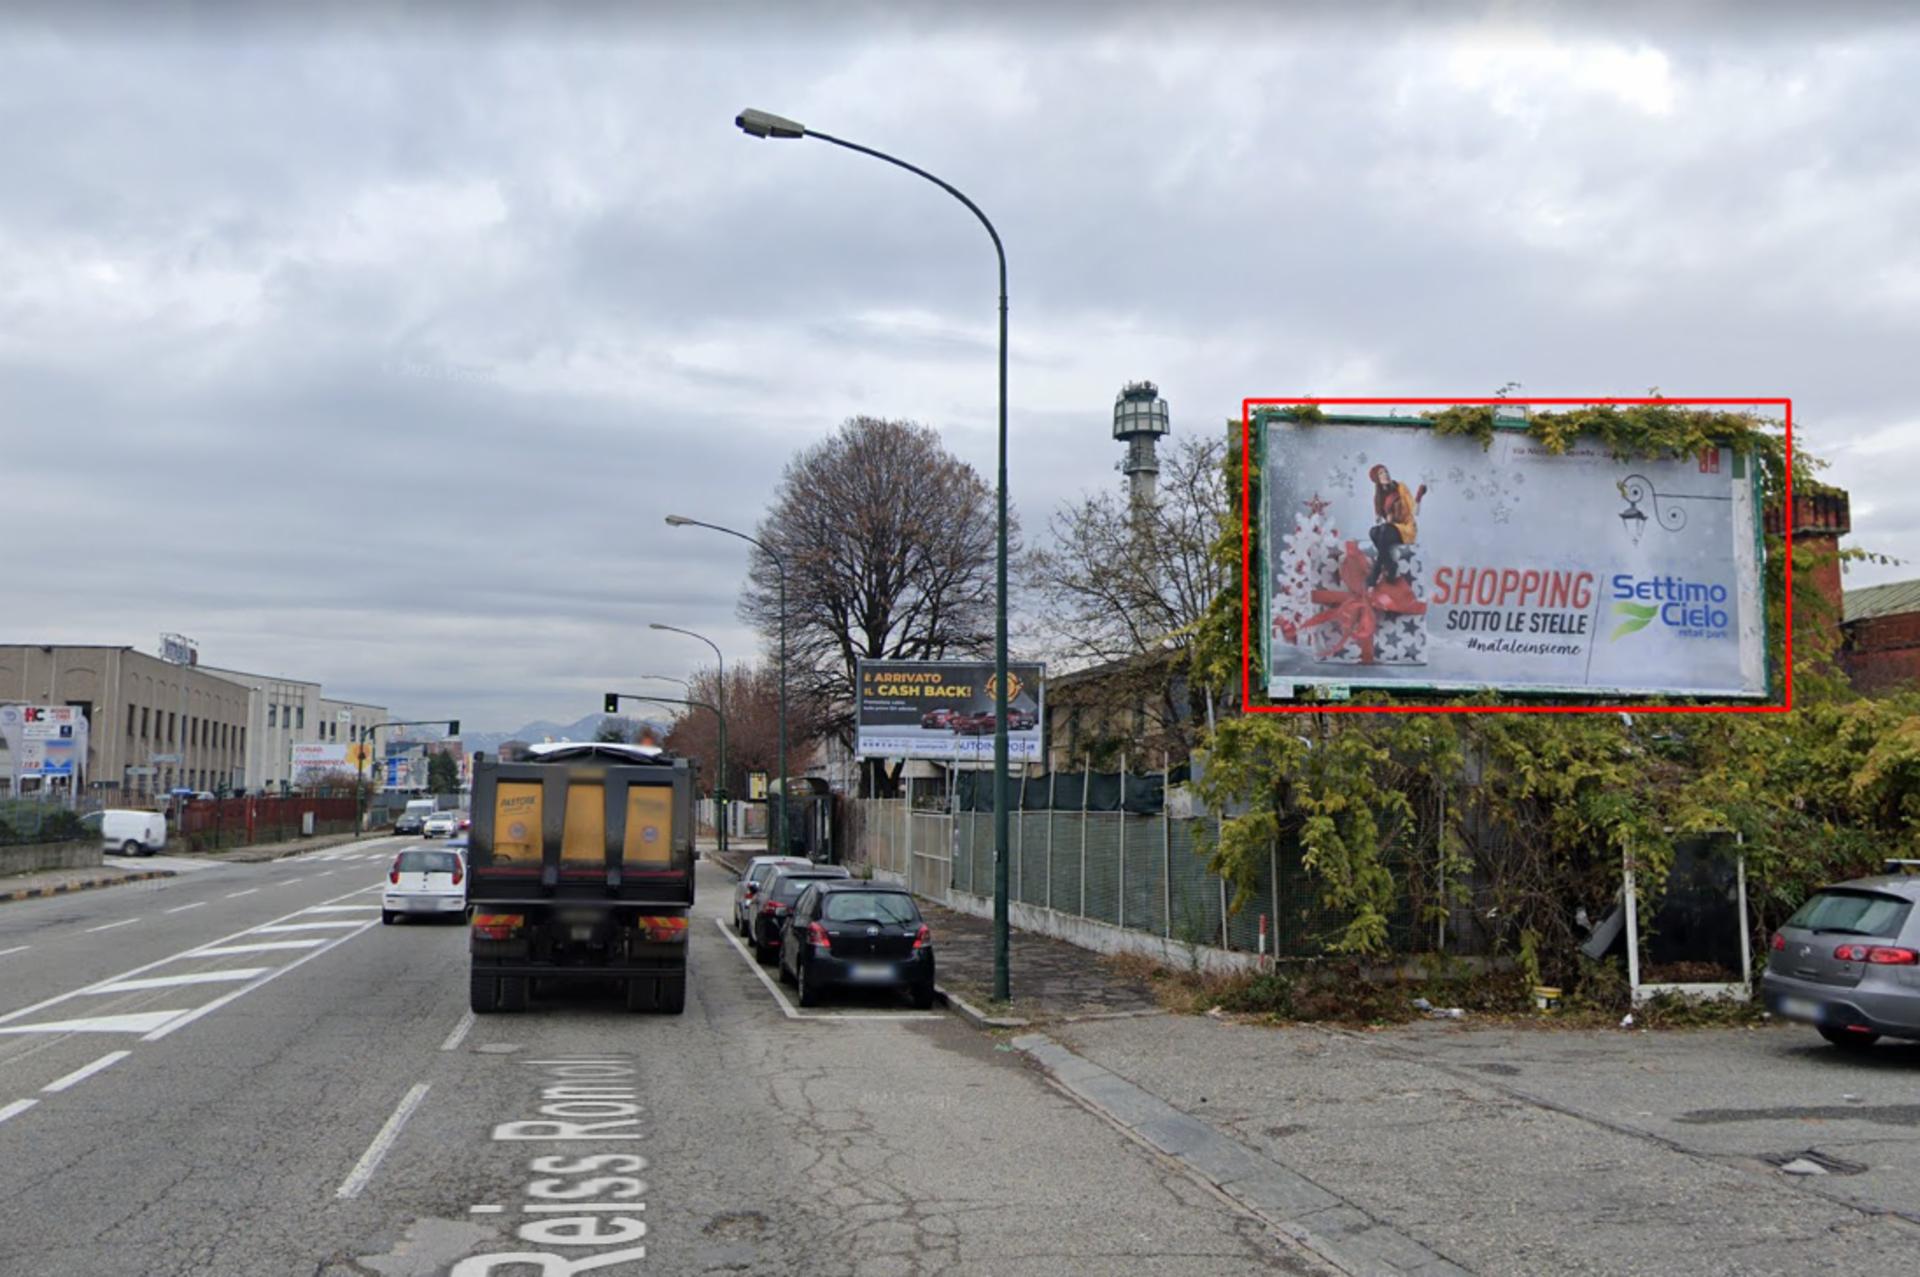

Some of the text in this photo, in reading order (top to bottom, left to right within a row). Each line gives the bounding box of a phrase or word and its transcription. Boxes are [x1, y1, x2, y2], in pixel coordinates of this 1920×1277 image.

[1431, 566, 1594, 609] SHOPPING
[1612, 574, 1727, 603] Settimo
[1446, 609, 1588, 635] SOTTO LE STELLE
[1661, 601, 1728, 629] Cielo
[1467, 637, 1581, 656] #nataleinsieme
[874, 672, 942, 684] ARRIVATO
[878, 685, 920, 697] CASH
[924, 685, 972, 698] BACK!
